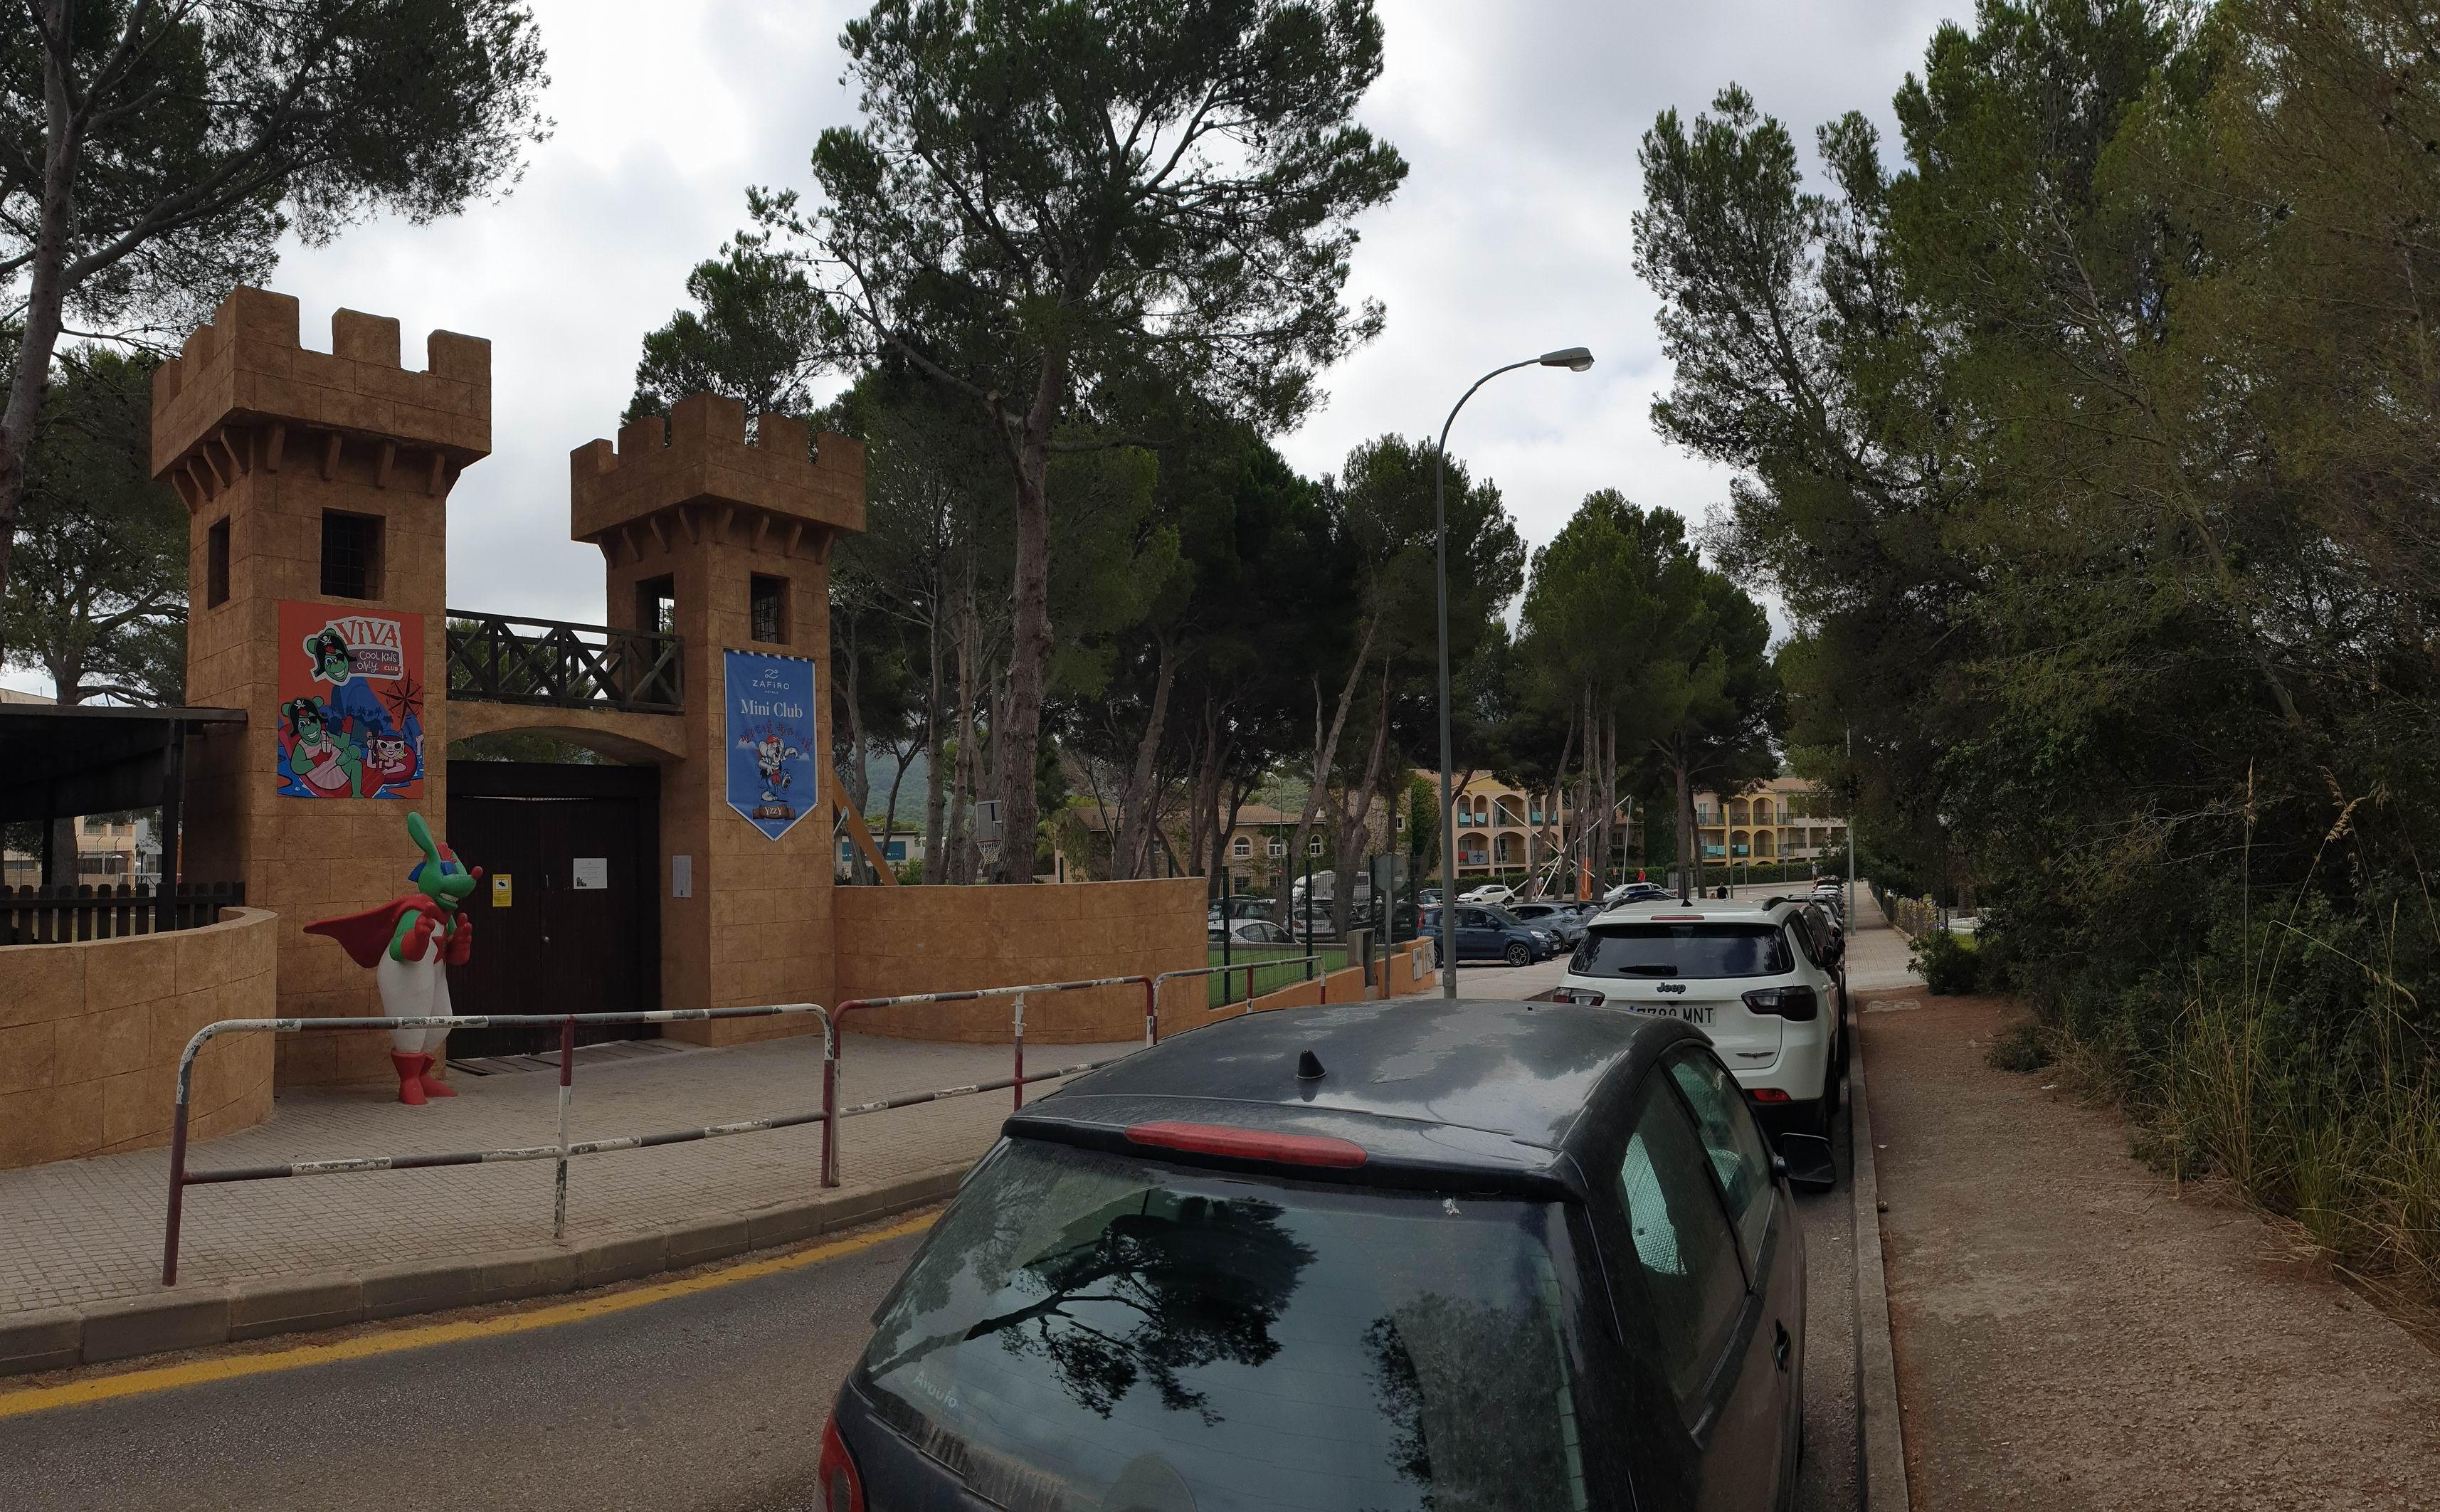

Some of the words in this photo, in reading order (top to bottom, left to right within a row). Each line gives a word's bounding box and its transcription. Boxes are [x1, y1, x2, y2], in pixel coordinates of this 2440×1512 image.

[334, 620, 398, 648] VIVA
[741, 699, 770, 716] Mini
[773, 702, 803, 719] Club
[1657, 982, 1686, 995] Jeep
[1683, 1008, 1713, 1023] MNT
